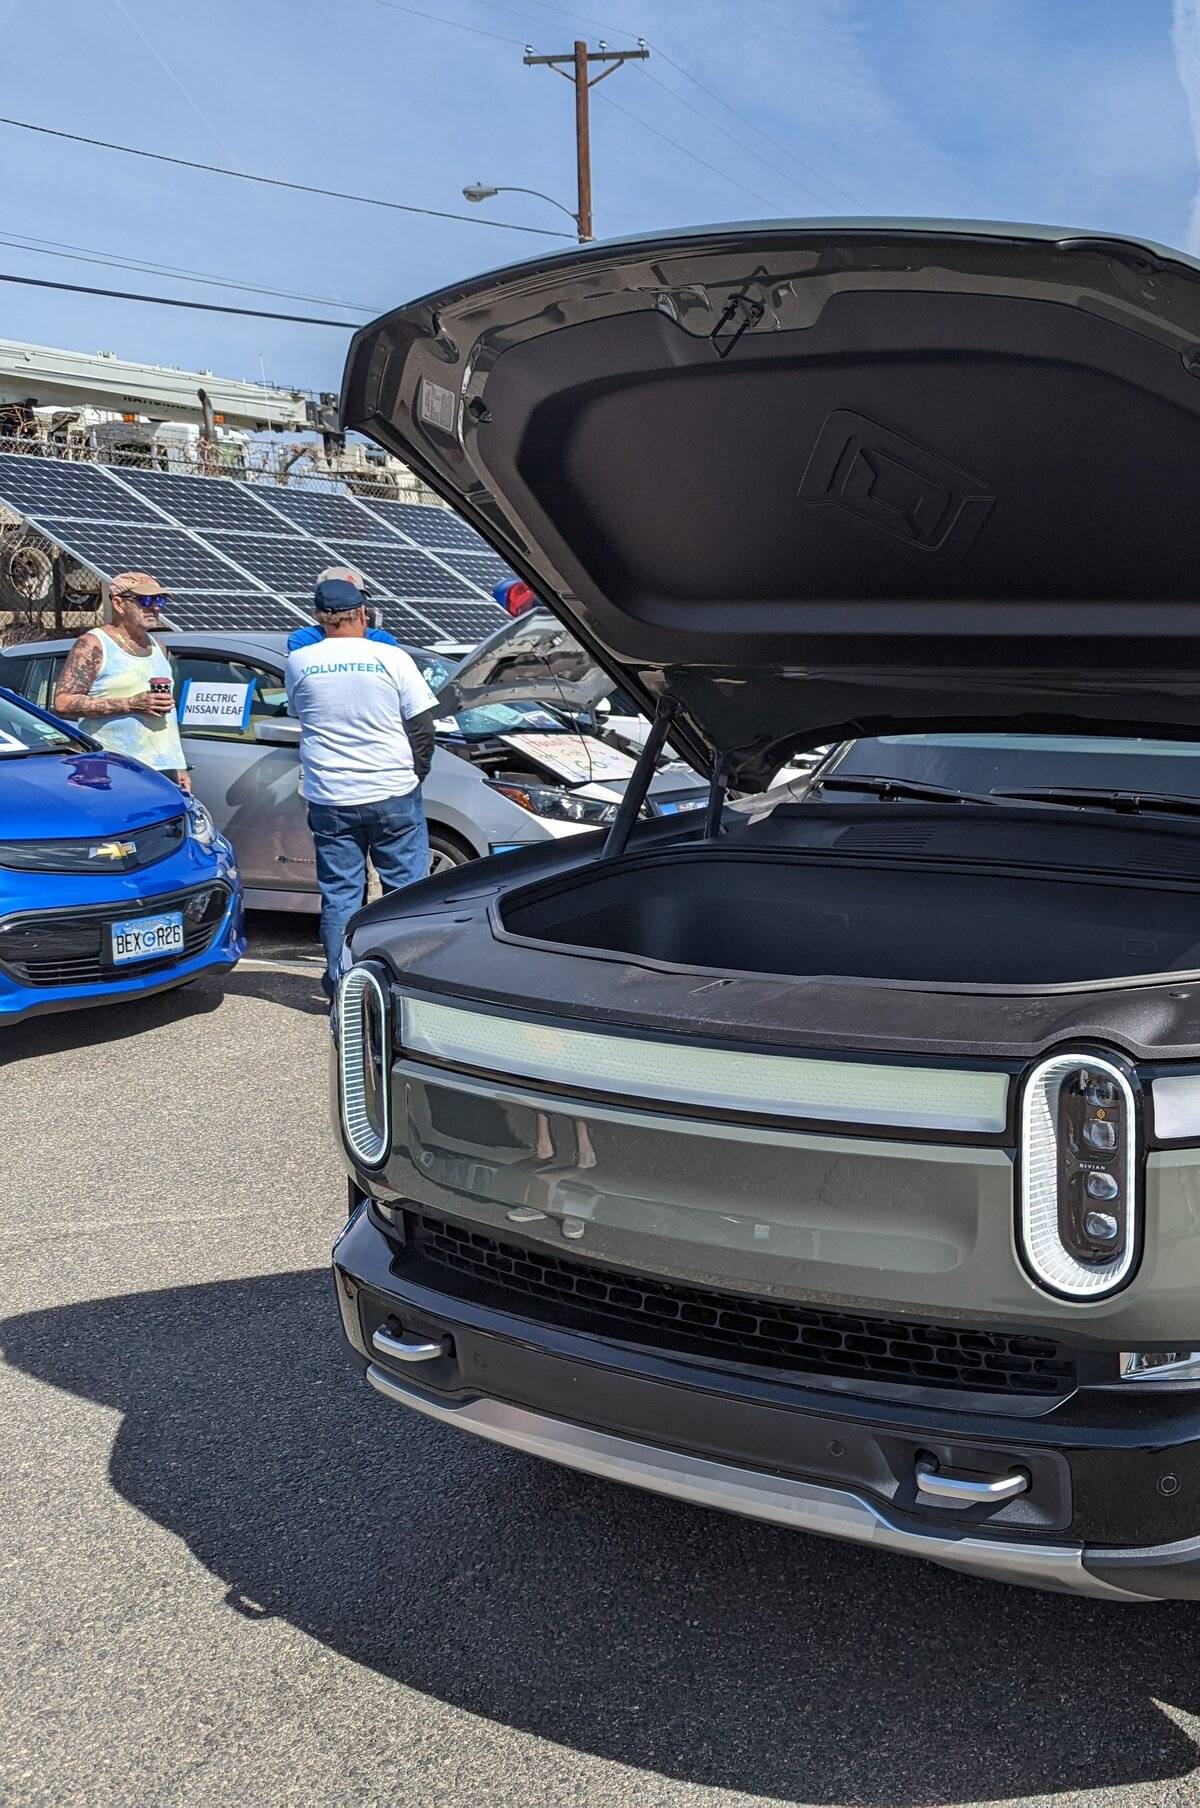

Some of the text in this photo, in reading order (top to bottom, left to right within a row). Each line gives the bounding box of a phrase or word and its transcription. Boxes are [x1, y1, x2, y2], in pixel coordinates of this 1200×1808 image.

[301, 662, 385, 675] VOLUNTEER
[195, 692, 238, 703] ELECTRIC
[185, 704, 244, 716] NISSAN LEAF
